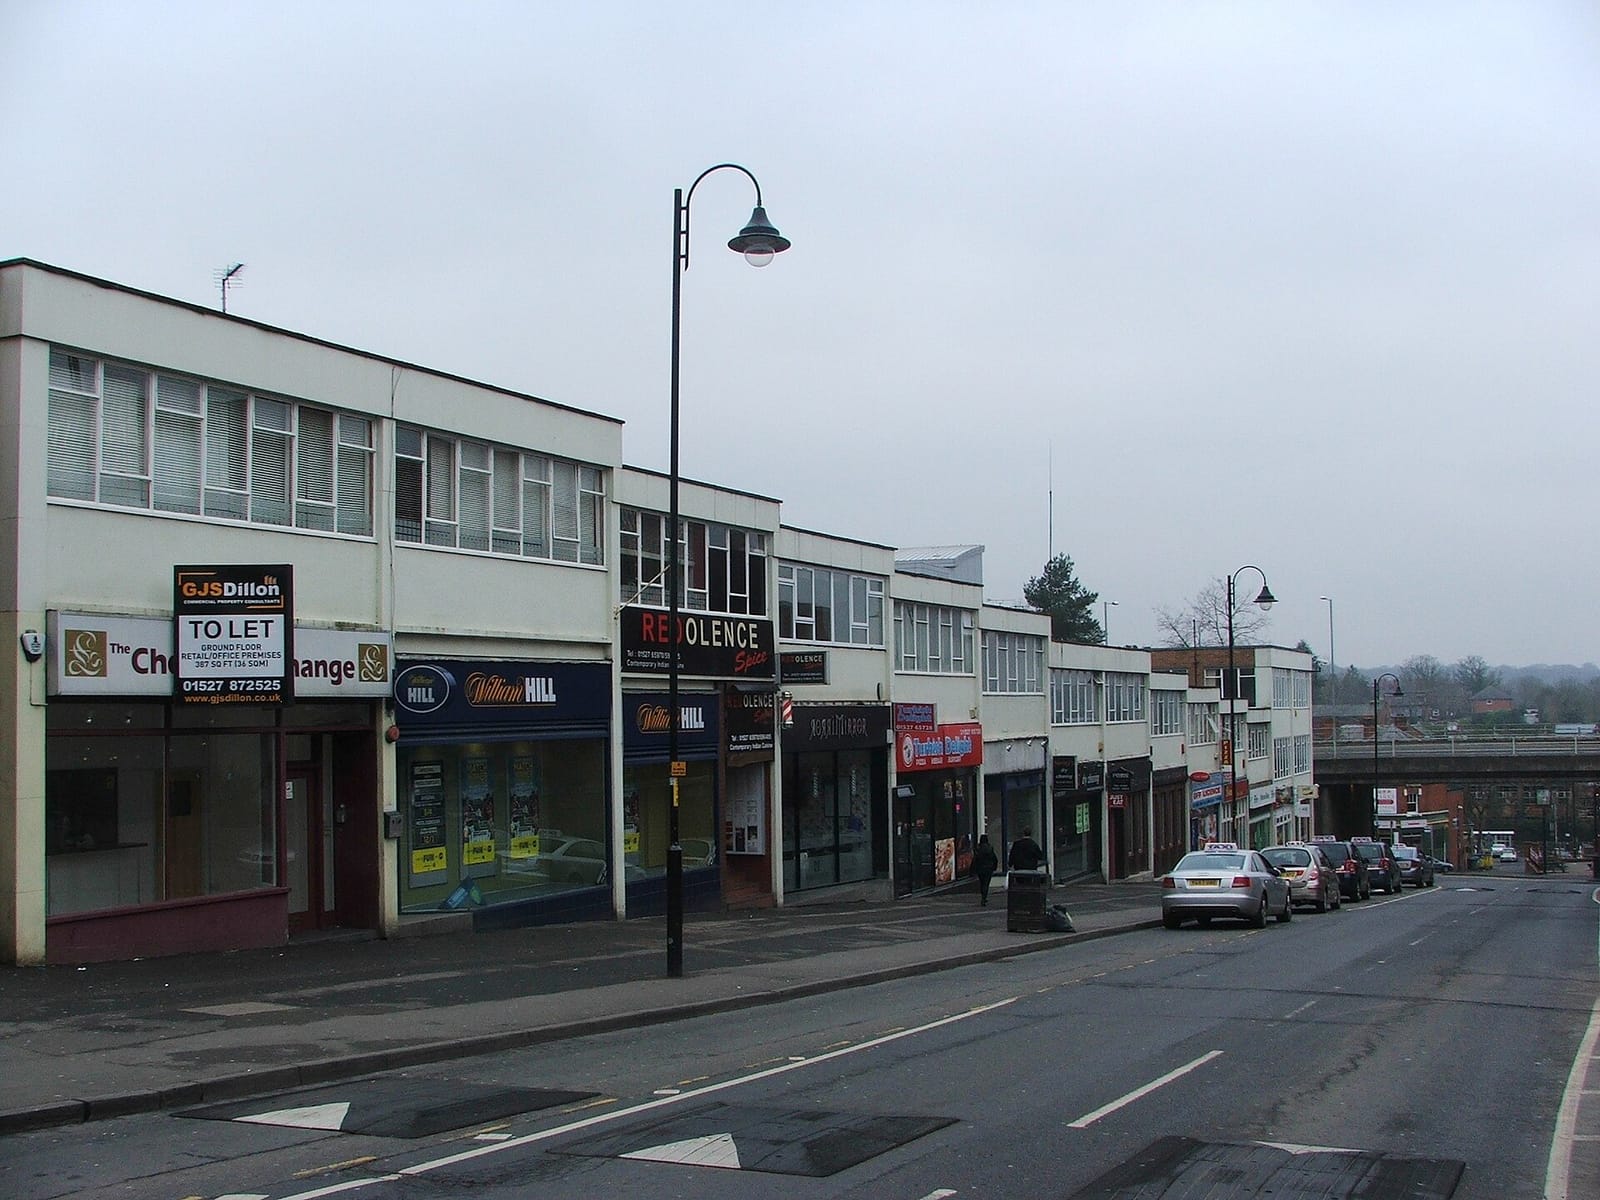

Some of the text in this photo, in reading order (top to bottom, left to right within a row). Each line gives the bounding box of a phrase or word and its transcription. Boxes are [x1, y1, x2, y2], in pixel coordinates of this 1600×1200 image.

[182, 581, 280, 597] GJSDillon
[188, 620, 275, 640] TO LET
[109, 643, 131, 655] The
[201, 643, 262, 652] GROUND FLOOR
[181, 652, 240, 660] RETAIL/OFFICE
[211, 660, 221, 668] SQ
[734, 651, 768, 672] Spice
[183, 680, 281, 692] 01527 872525
[464, 671, 557, 704] William HILL
[407, 687, 435, 703] HILL
[681, 706, 705, 729] HILL
